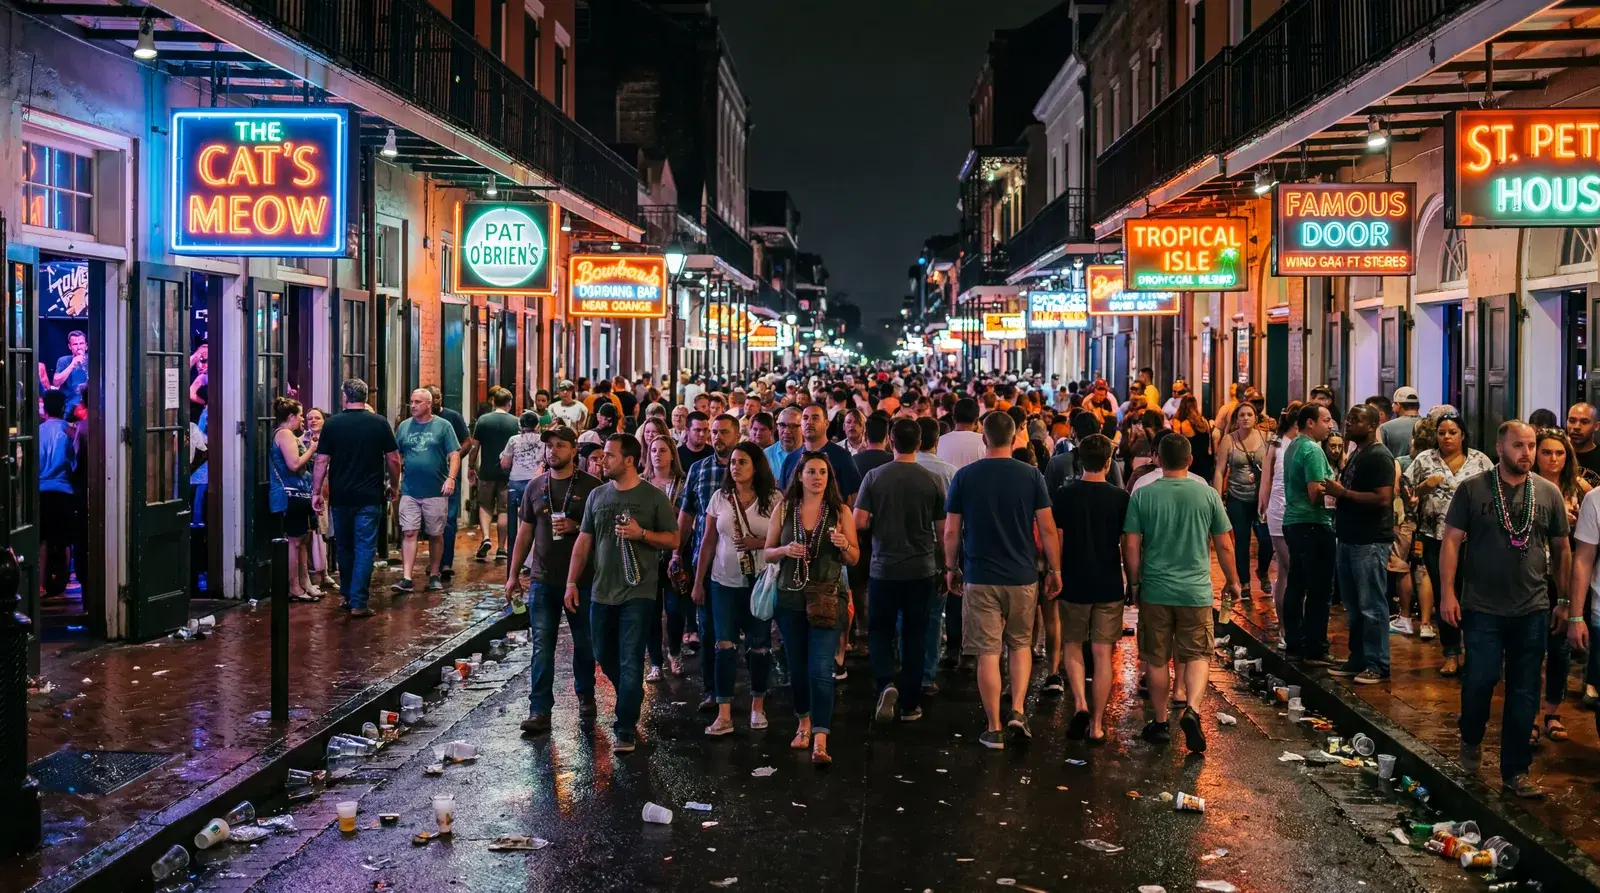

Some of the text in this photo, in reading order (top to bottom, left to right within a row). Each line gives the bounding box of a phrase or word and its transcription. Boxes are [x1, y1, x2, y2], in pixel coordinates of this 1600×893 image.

[235, 121, 283, 142] THE
[1467, 122, 1600, 172] ST. PET
[197, 142, 320, 187] CAT'S
[188, 194, 328, 236] MEOW
[1285, 191, 1407, 217] FAMOUS
[485, 223, 526, 242] PAT
[1133, 226, 1241, 247] TROPICAL
[1302, 221, 1389, 247] DOOR
[470, 242, 539, 266] O'BRIEN'S
[1163, 250, 1211, 272] ISLE
[637, 286, 658, 299] BAR
